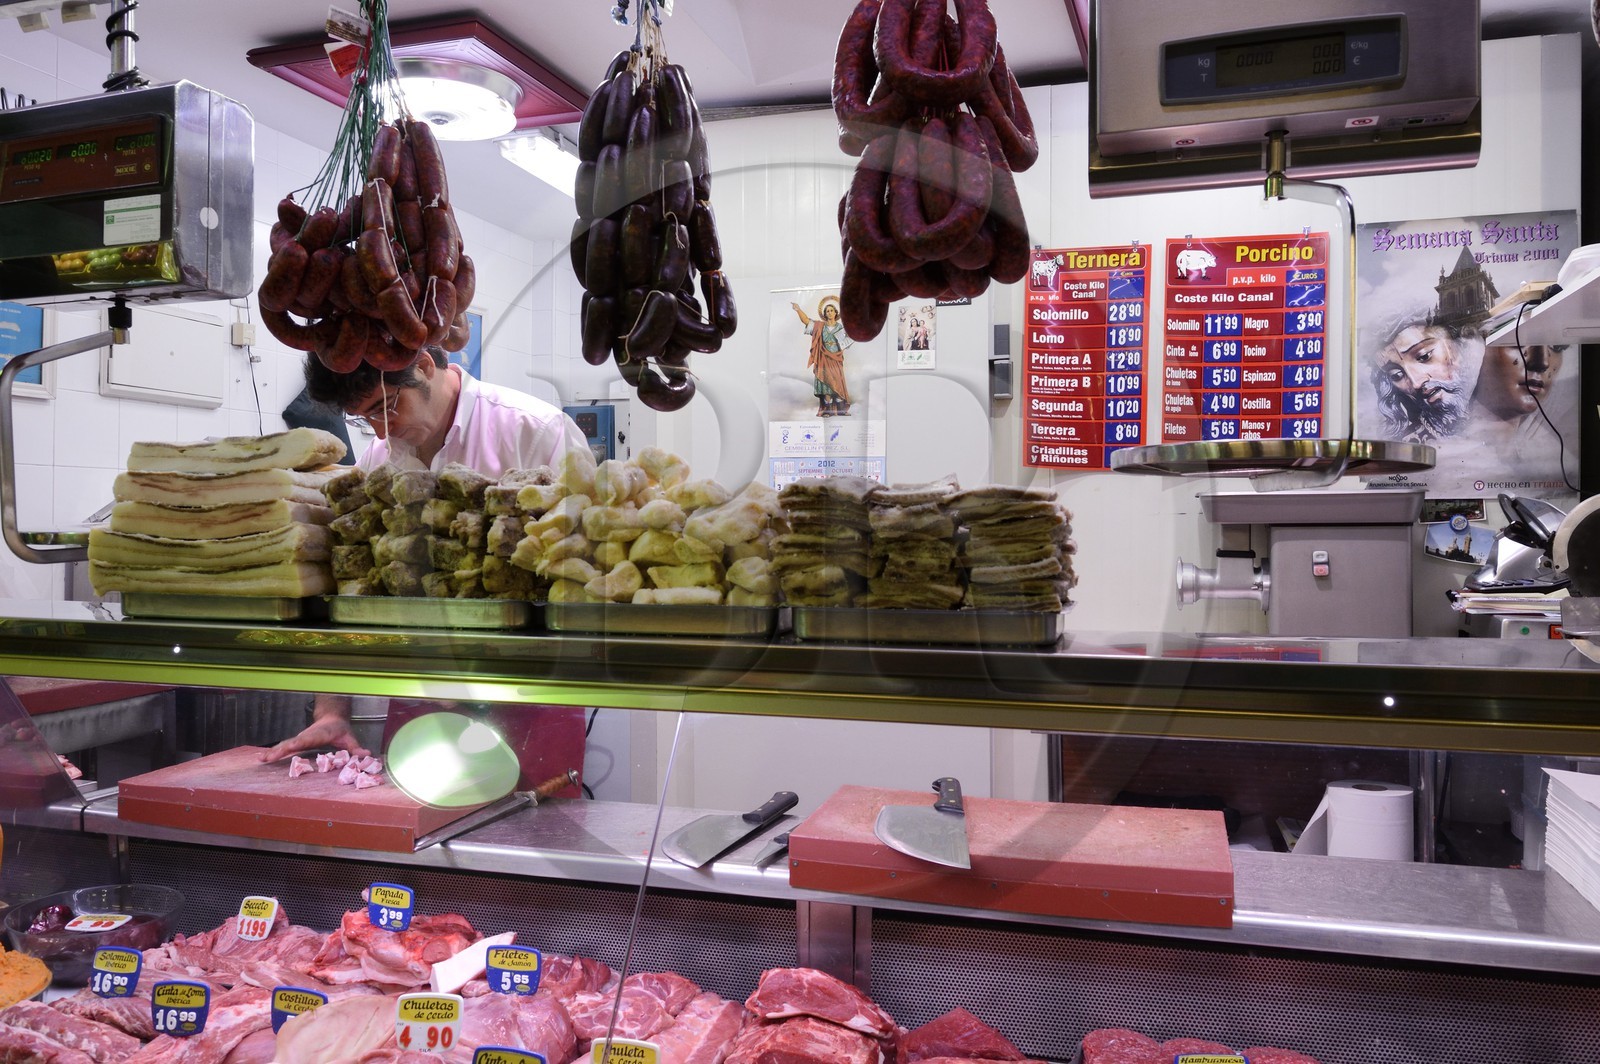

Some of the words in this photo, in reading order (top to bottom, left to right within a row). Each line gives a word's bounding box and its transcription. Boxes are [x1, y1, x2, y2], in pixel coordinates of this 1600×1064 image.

[1198, 57, 1210, 68] kg
[1353, 56, 1360, 65] €
[1200, 74, 1208, 82] T
[1373, 228, 1473, 252] Semana
[1481, 221, 1559, 245] Santa
[1067, 252, 1141, 269] Ternera
[1236, 244, 1313, 263] Porcino
[1474, 251, 1519, 264] Triana
[1523, 248, 1559, 261] 2009
[1064, 282, 1087, 290] Coste
[1233, 276, 1255, 285] p.v.p.
[1260, 274, 1276, 283] kilo
[1175, 293, 1208, 303] Coste
[1212, 293, 1234, 302] Kilo
[1238, 292, 1273, 302] Canal
[1033, 309, 1089, 320] Solomillo
[1109, 303, 1141, 321] 28'90
[1167, 319, 1200, 331] Solomillo
[1205, 316, 1238, 334] 11'99
[1245, 318, 1269, 331] Magro
[1297, 313, 1322, 331] 3'90
[1033, 332, 1065, 343] Lomo
[1109, 328, 1141, 345] 18'90
[1166, 345, 1185, 357] Cinta
[1212, 343, 1237, 359] 6'99
[1244, 345, 1266, 356] Tocino
[1295, 340, 1320, 358] 4'80
[1032, 353, 1079, 365] Primera
[1083, 354, 1091, 364] A
[1108, 351, 1140, 369] 12'80
[1166, 367, 1197, 379] Chuletas
[1212, 369, 1236, 385] 5'50
[1243, 371, 1276, 382] Espinazo
[1294, 367, 1320, 384] 4'80
[1031, 375, 1078, 387] Primera
[1082, 377, 1091, 387] B
[1108, 376, 1140, 393] 10'99
[1032, 399, 1083, 413] Segunda
[1108, 400, 1139, 417] 10'20
[1165, 394, 1194, 406] Chuletas
[1211, 395, 1235, 412] 4'90
[1242, 398, 1271, 409] Costilla
[1294, 394, 1318, 411] 5'65
[1031, 423, 1075, 436] Tercera
[1116, 424, 1138, 441] 8'60
[1165, 423, 1186, 435] Filetes
[1211, 421, 1235, 438] 5'65
[1242, 420, 1265, 430] Manos
[1266, 421, 1271, 432] y
[1293, 420, 1318, 438] 3'99
[1242, 431, 1260, 439] rabos
[1032, 445, 1088, 455] Criadillas
[1031, 455, 1038, 463] y
[1041, 454, 1088, 464] Riñones
[375, 888, 404, 899] Papada
[244, 900, 268, 910] Secreto
[99, 952, 137, 963] Solomillo
[494, 949, 529, 960] Filetes
[501, 971, 529, 991] 5'65
[157, 986, 178, 997] Cinta
[279, 993, 320, 1006] Costillas
[404, 1000, 454, 1011] Chuletas
[155, 1009, 196, 1030] 16'99
[602, 1045, 645, 1059] huleta
